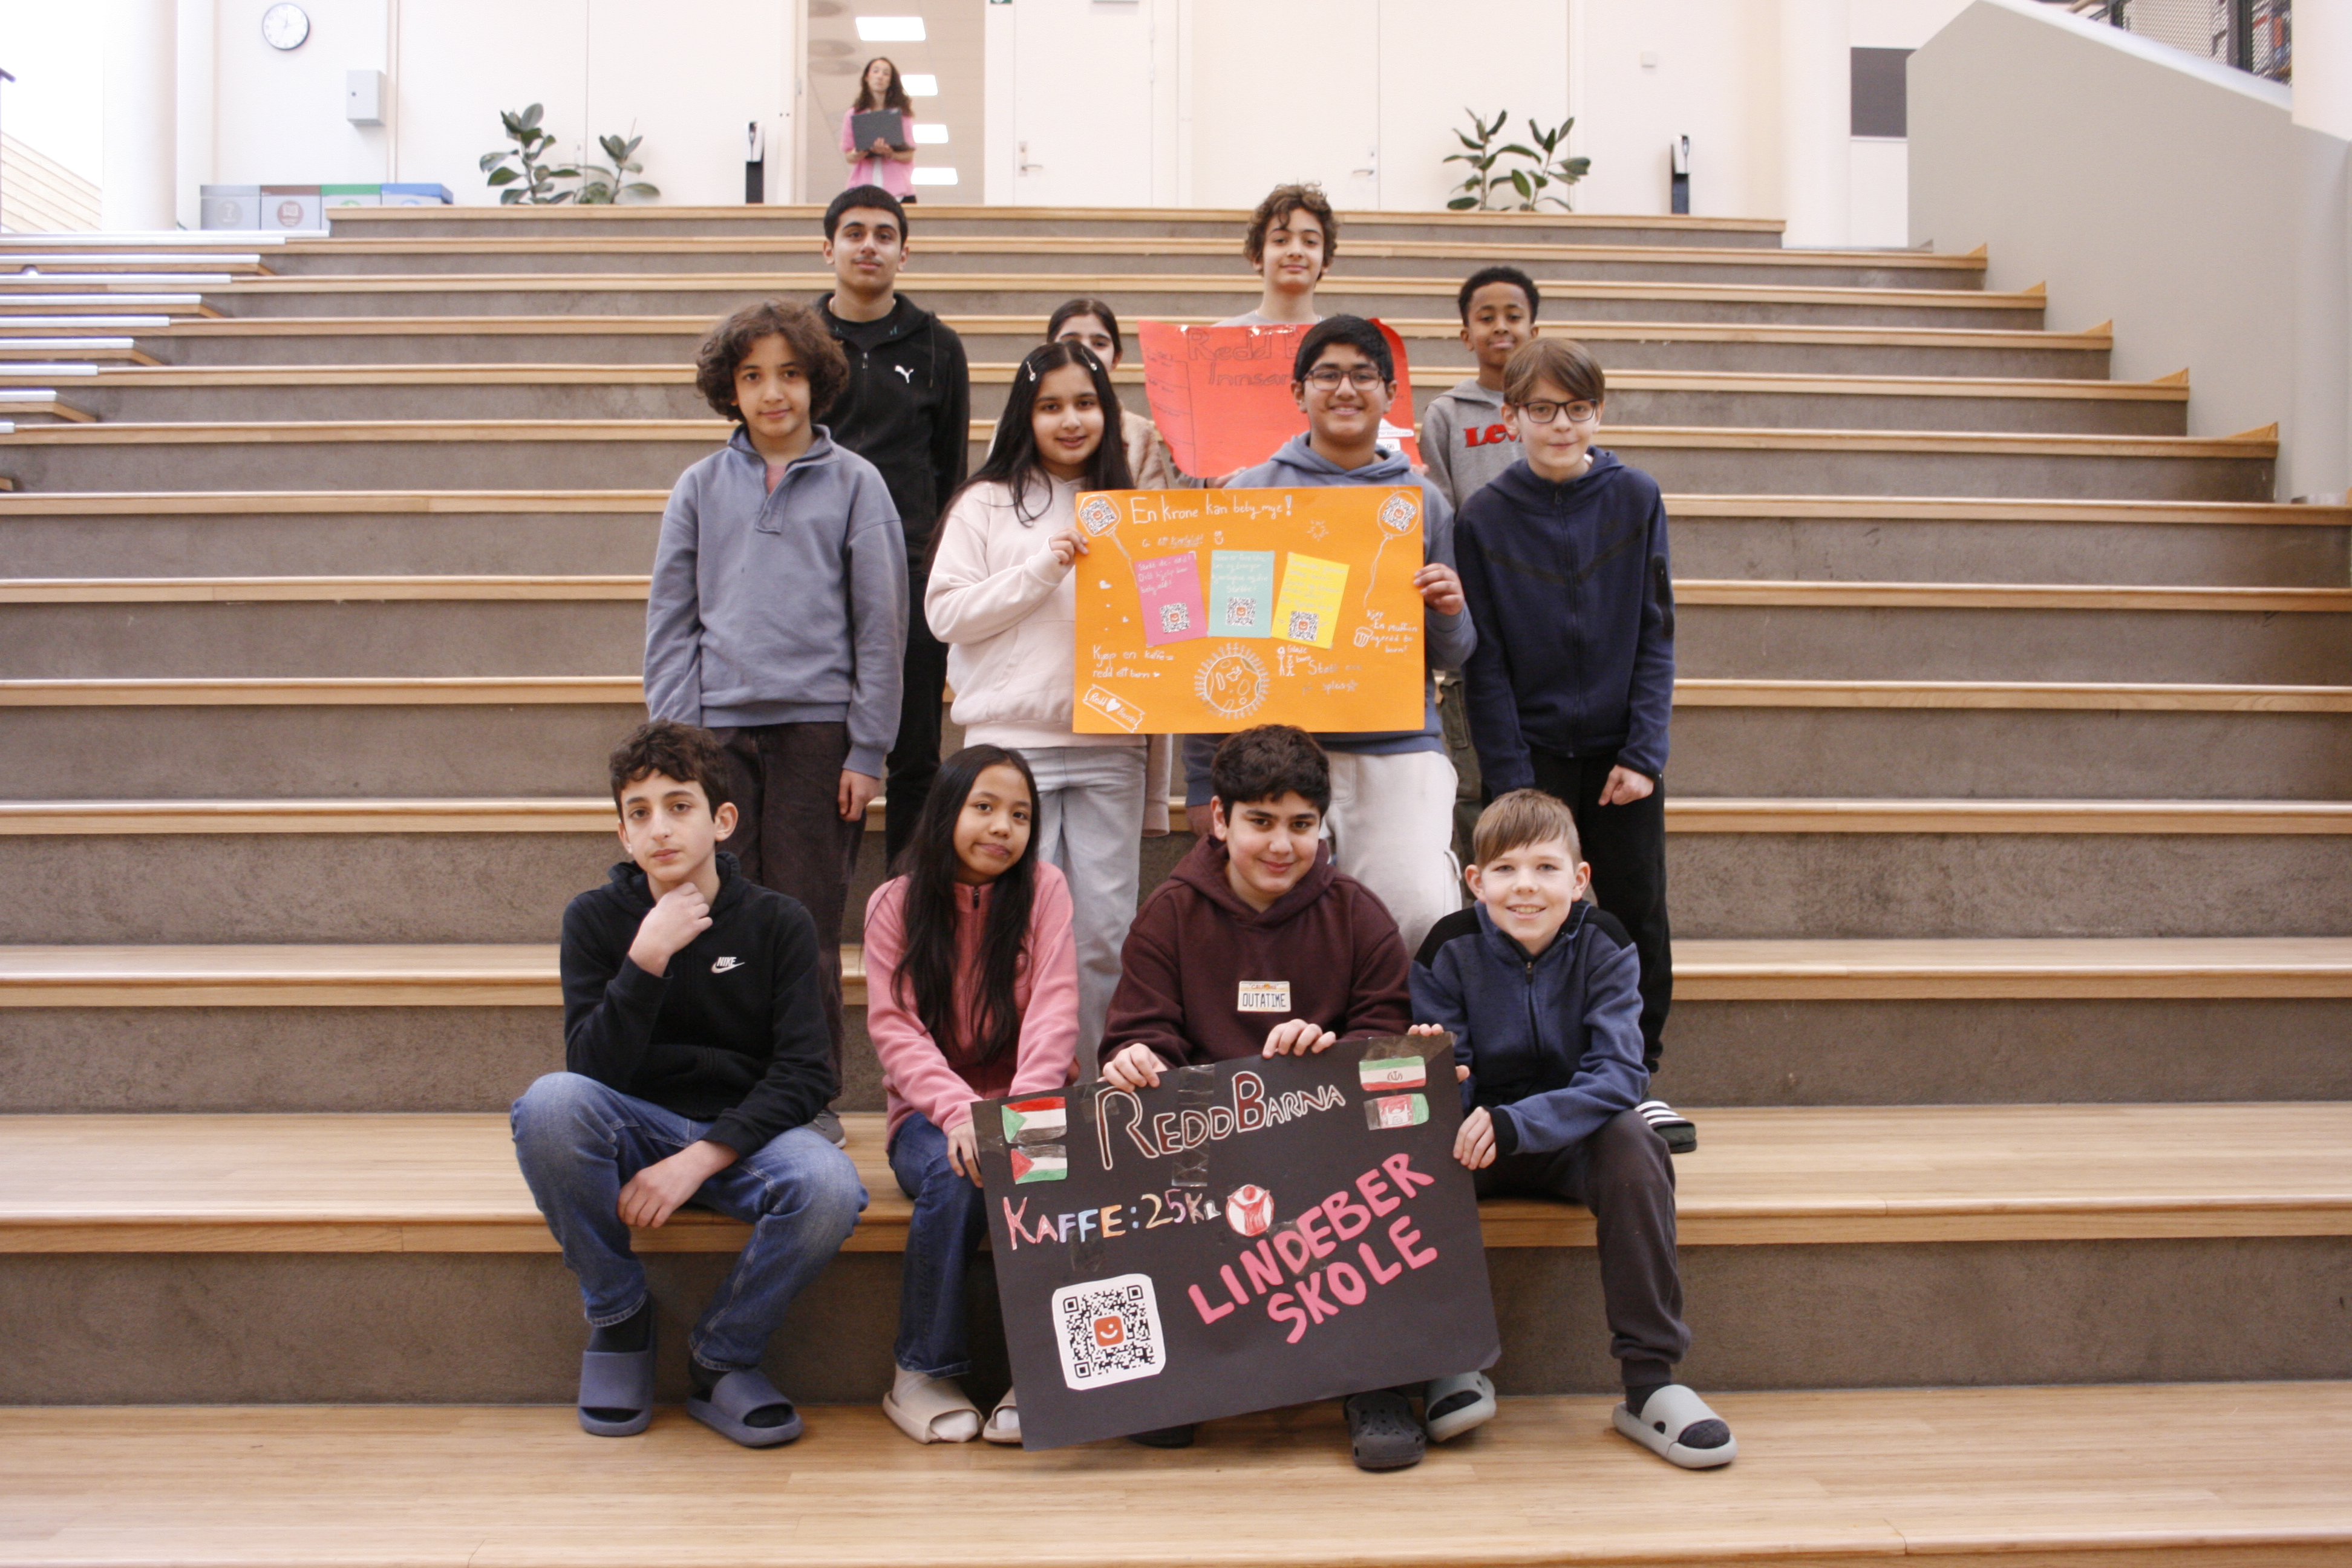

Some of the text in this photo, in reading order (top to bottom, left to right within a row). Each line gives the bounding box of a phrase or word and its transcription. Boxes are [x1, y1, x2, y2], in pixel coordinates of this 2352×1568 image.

[1187, 327, 1272, 361] Redd
[1129, 497, 1158, 524] En
[1161, 495, 1199, 522] krone
[1206, 494, 1228, 515] kan
[1233, 495, 1261, 520] bety
[1093, 644, 1117, 668] Kjøp
[1123, 651, 1137, 659] en
[1093, 666, 1114, 678] redd
[1089, 692, 1109, 707] Redd
[716, 956, 737, 967] NIKE
[1243, 993, 1287, 1007] OUTATIME
[1187, 1152, 1436, 1325] LINDEBER
[1267, 1215, 1439, 1344] SKOLE
